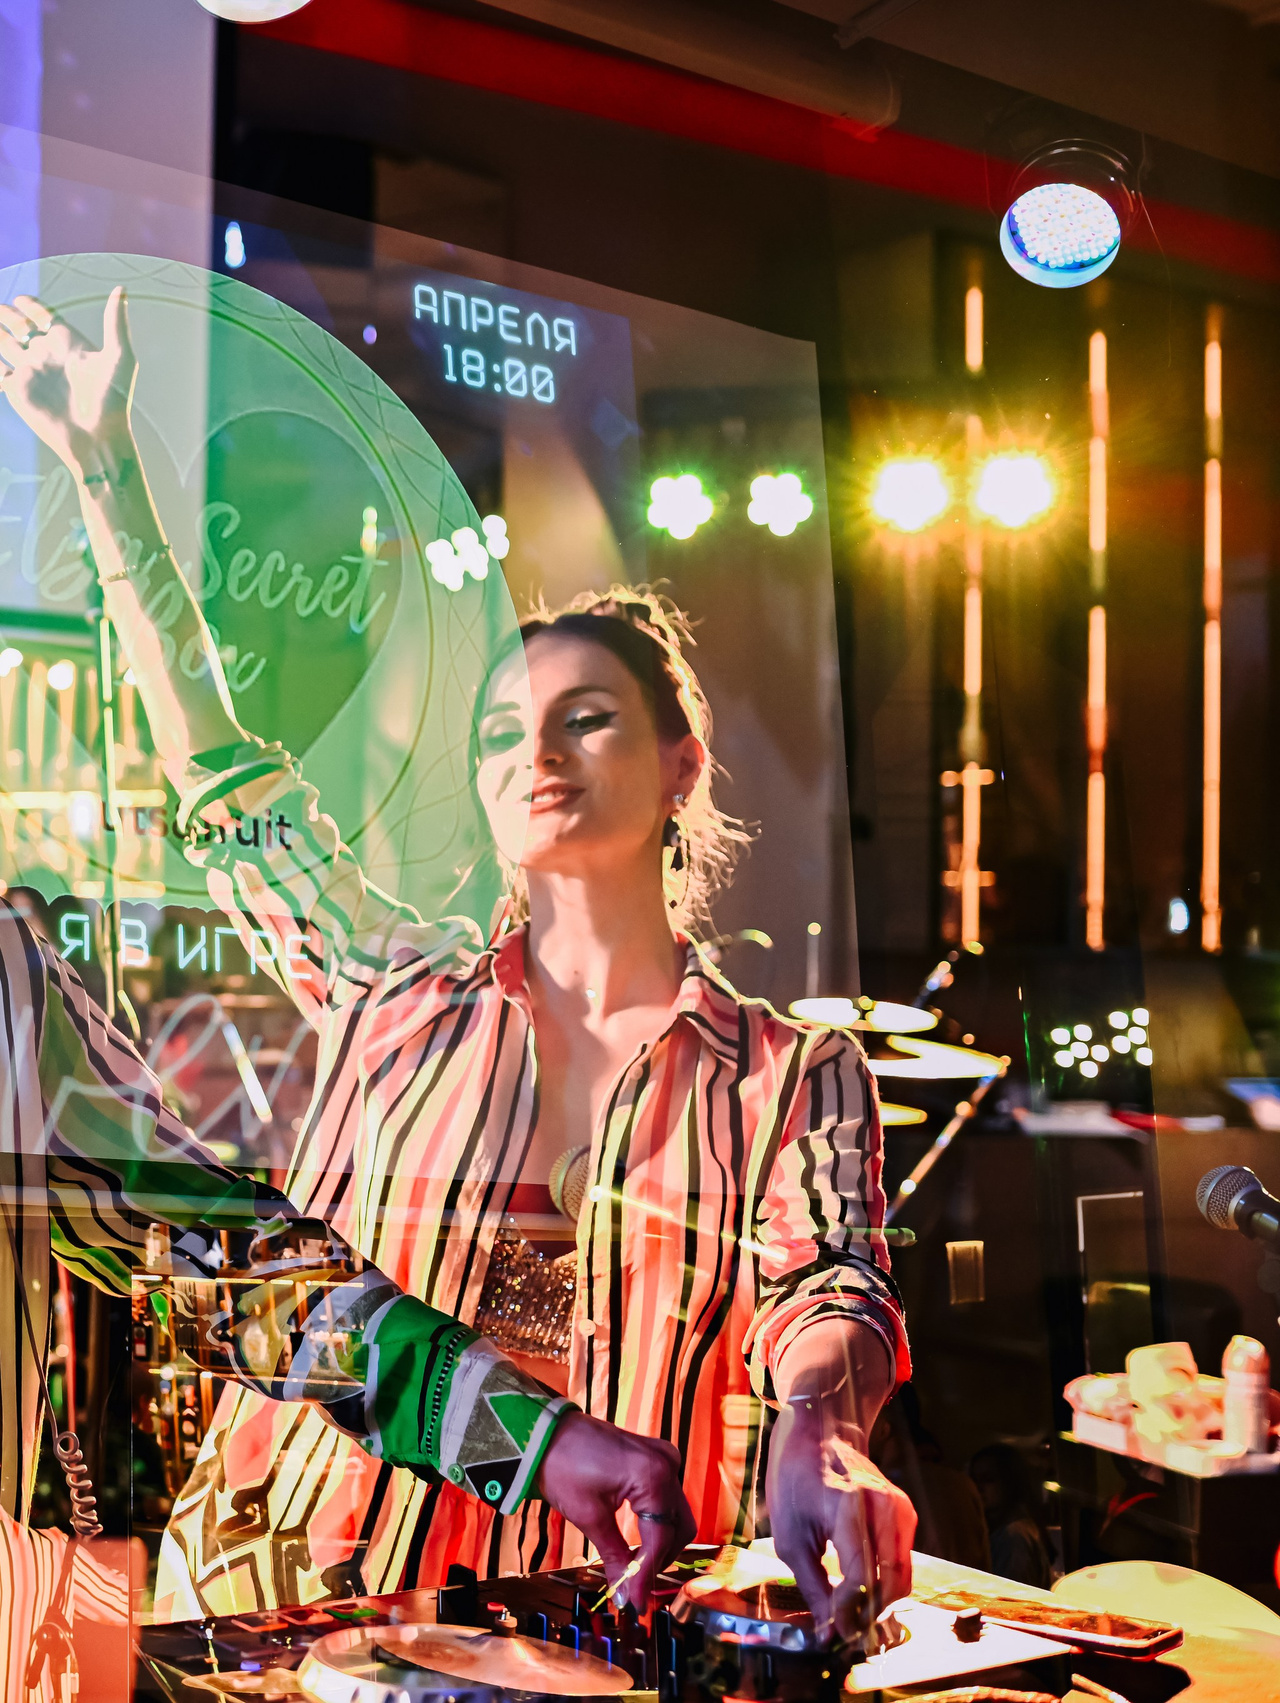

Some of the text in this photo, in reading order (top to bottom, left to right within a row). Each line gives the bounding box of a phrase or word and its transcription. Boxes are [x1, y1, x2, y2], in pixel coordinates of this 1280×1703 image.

[414, 284, 577, 356] АПРЕЛЯ
[443, 344, 555, 403] 18:00
[195, 501, 388, 634] Secret
[60, 914, 312, 980] Я В ИГРЕ
